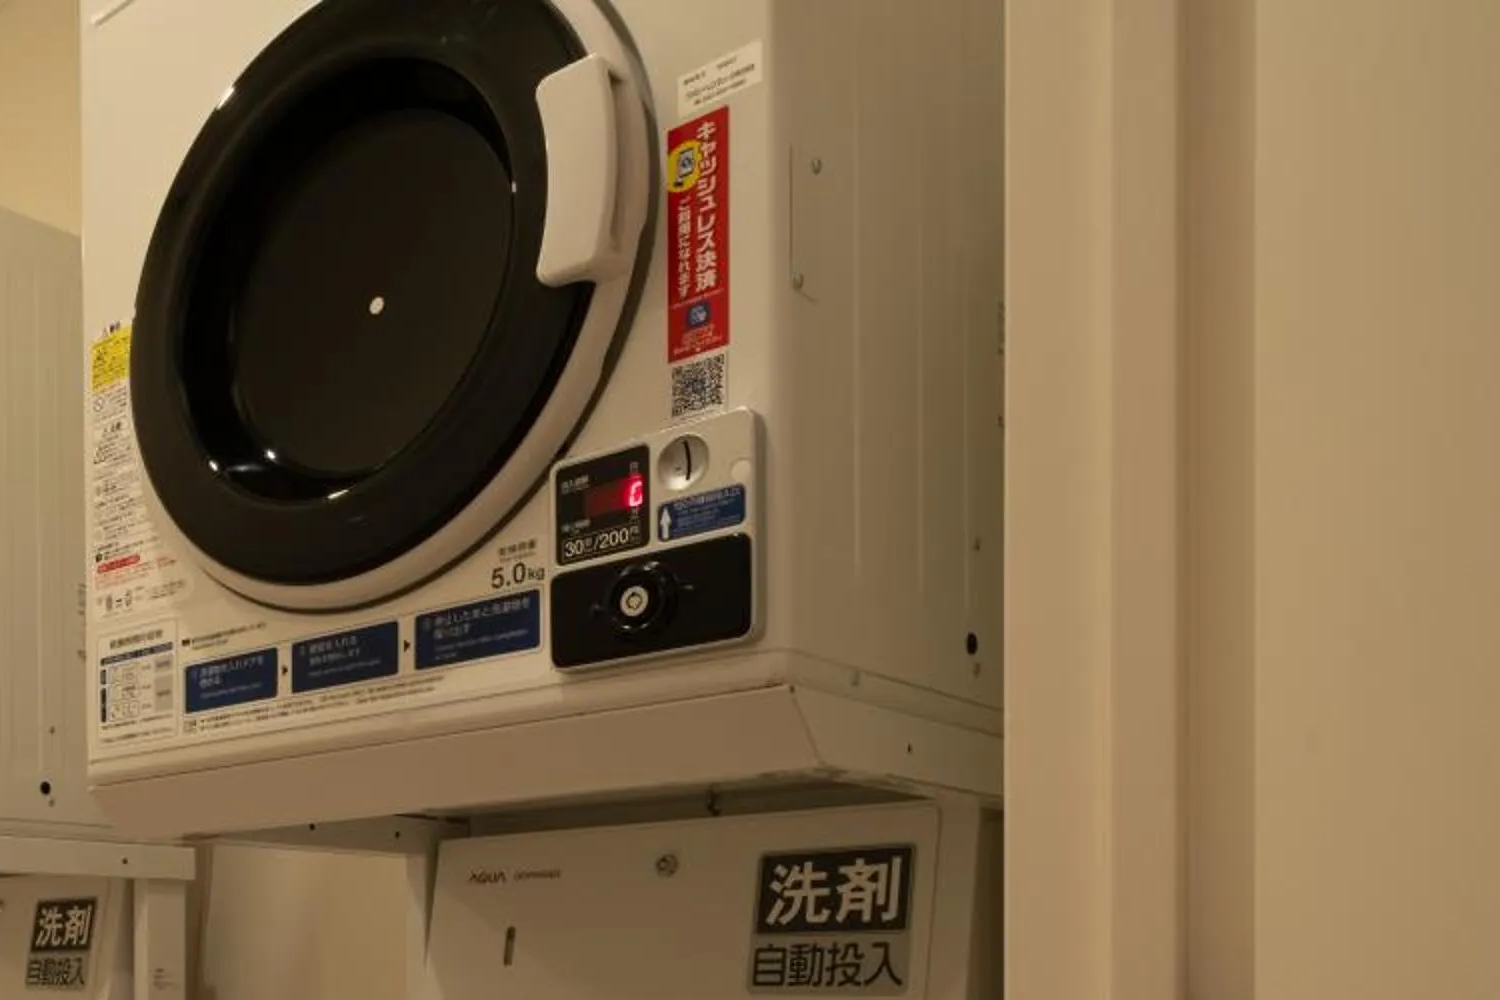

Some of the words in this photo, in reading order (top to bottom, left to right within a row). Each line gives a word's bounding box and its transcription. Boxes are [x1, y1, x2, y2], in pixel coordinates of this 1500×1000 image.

[765, 855, 902, 925] 洗剤
[36, 904, 92, 947] 洗剤
[752, 941, 903, 988] 自動投入
